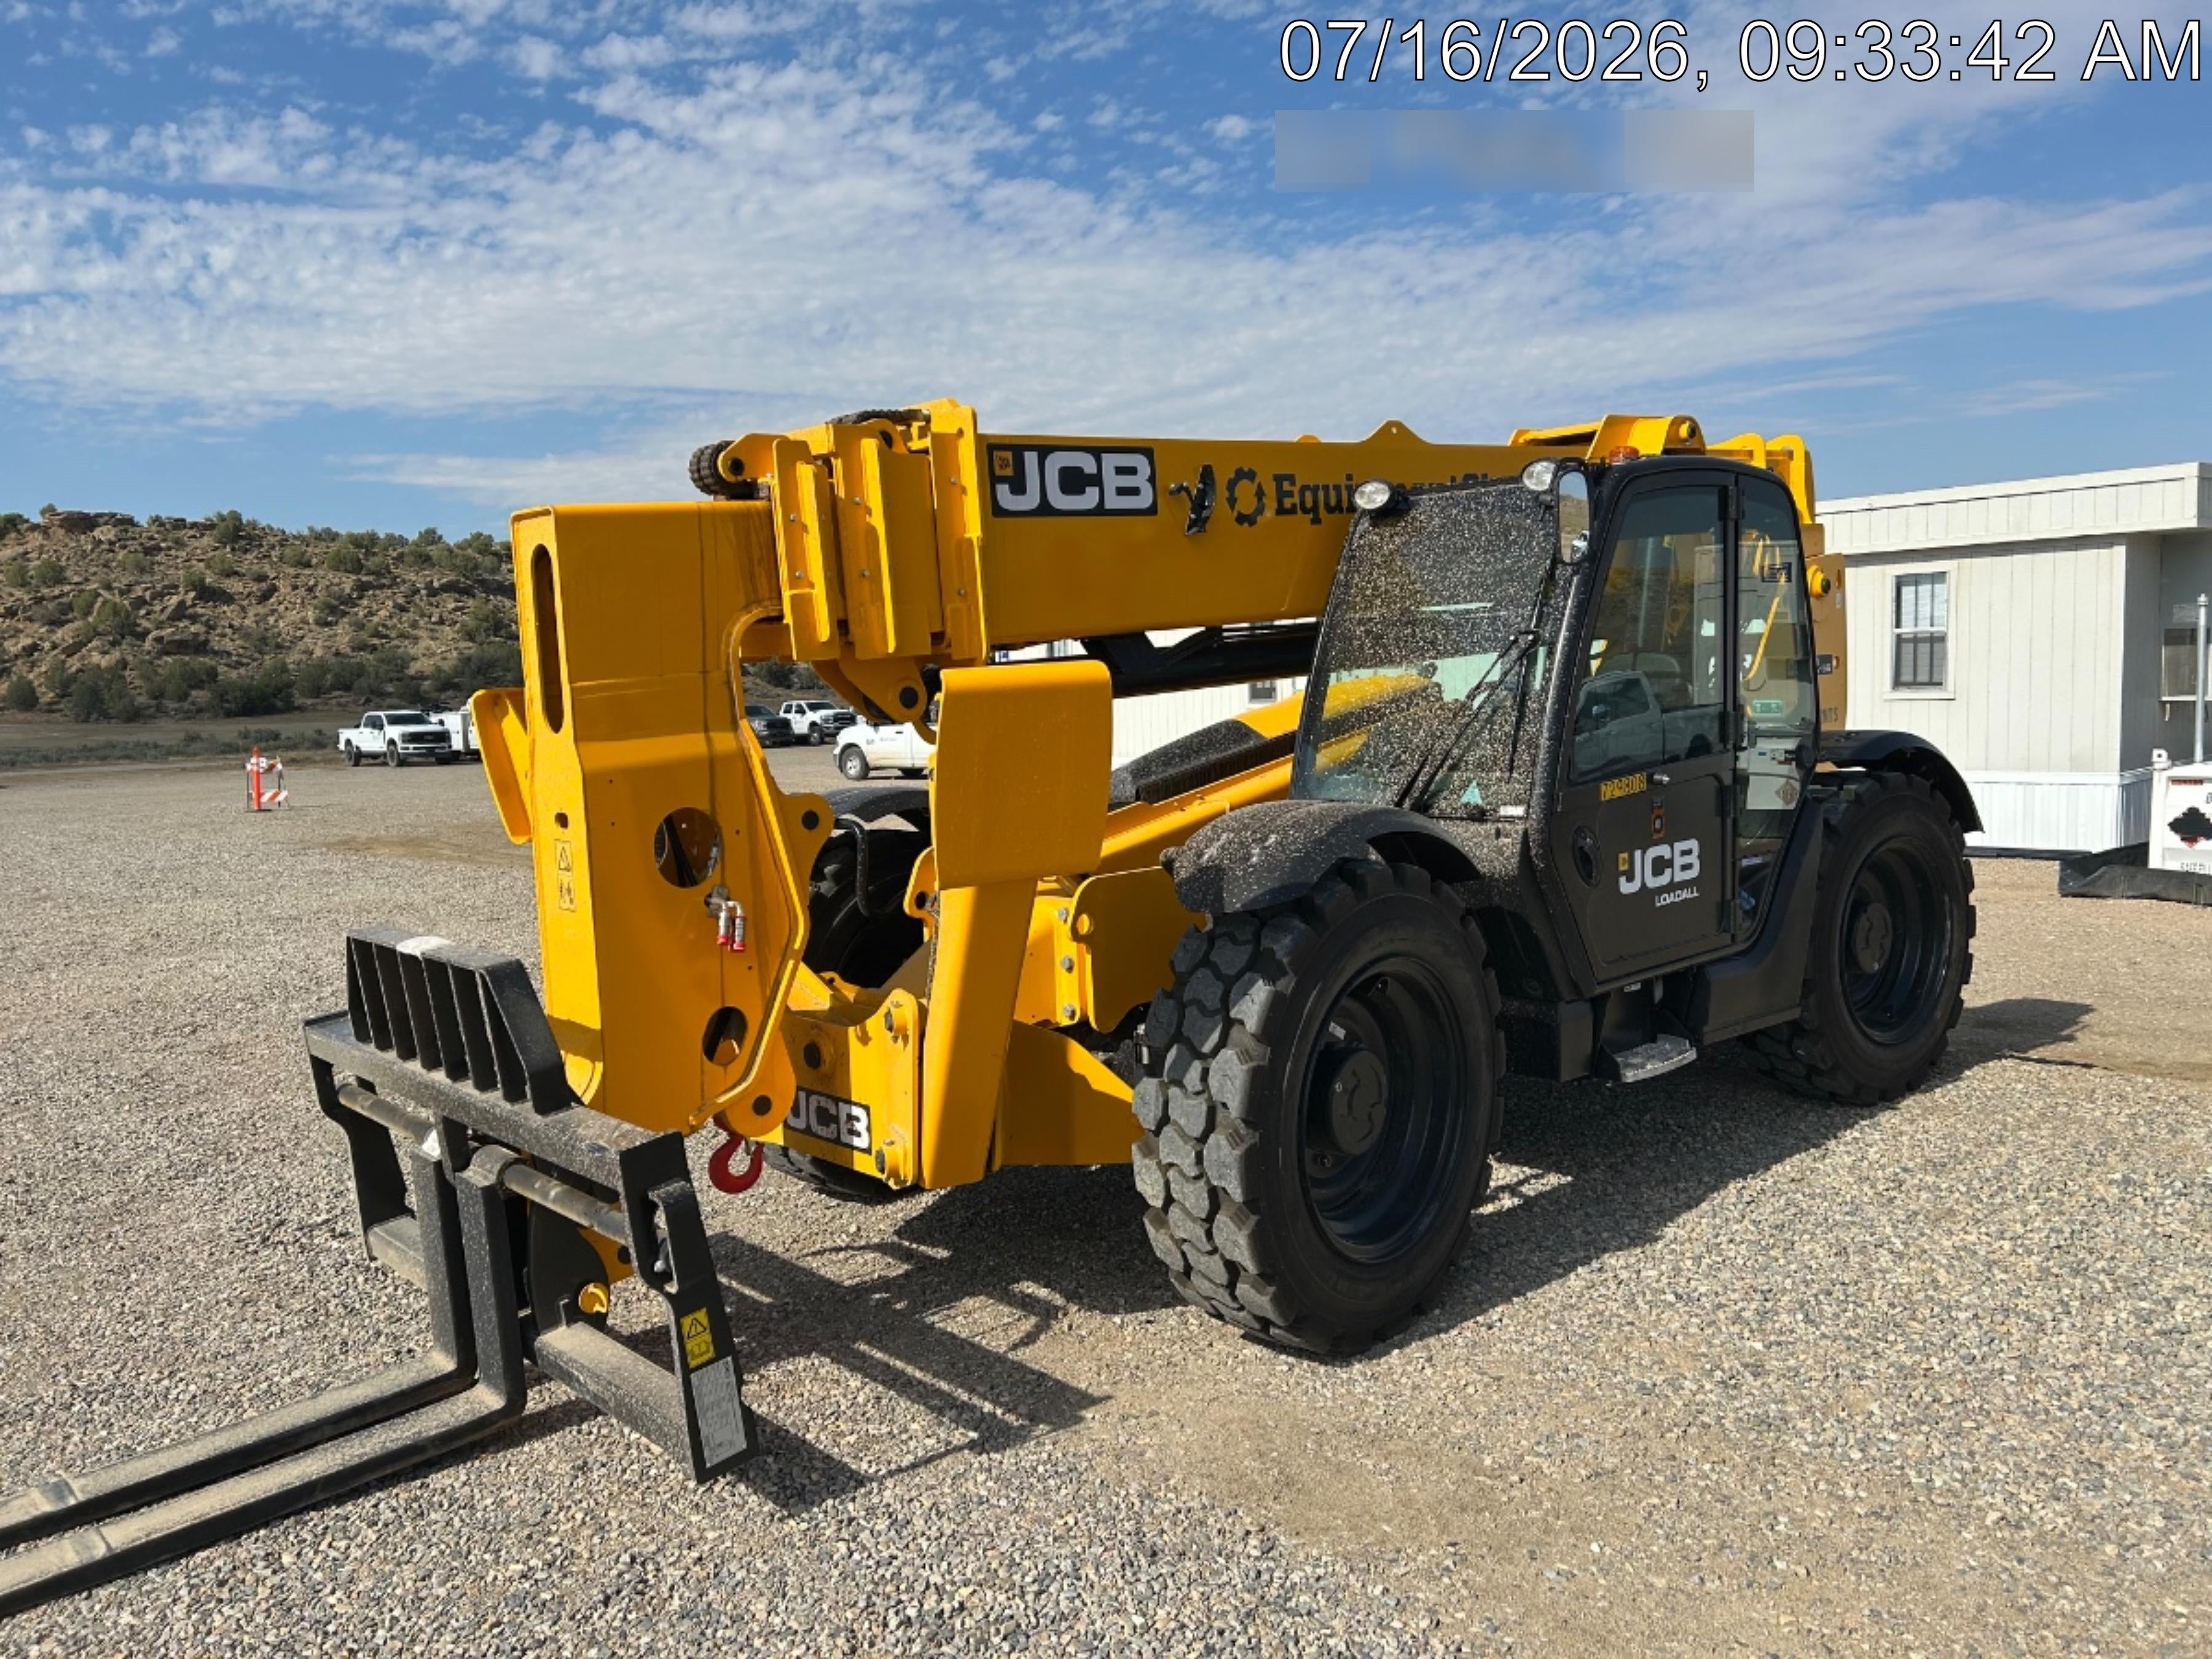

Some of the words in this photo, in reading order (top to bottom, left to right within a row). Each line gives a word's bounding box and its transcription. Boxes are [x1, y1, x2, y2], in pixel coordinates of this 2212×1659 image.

[995, 450, 1153, 511] JCB
[1618, 838, 1700, 894] JCB
[1655, 885, 1700, 908] LOADALL
[787, 1091, 871, 1150] JCB
